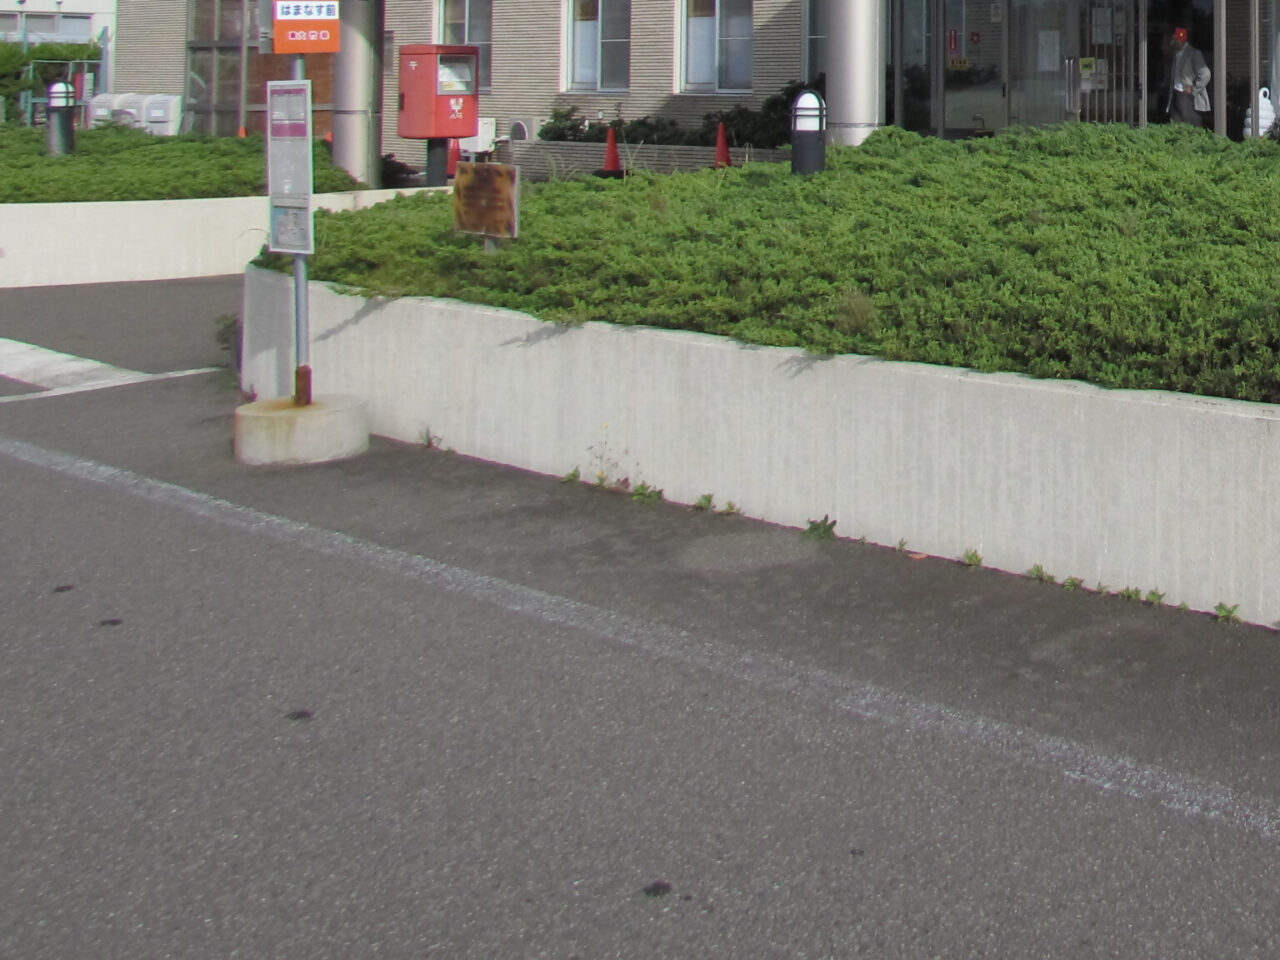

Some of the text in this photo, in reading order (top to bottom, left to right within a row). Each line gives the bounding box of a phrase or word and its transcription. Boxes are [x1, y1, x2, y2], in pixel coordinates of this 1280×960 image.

[280, 4, 336, 17] はまなす前
